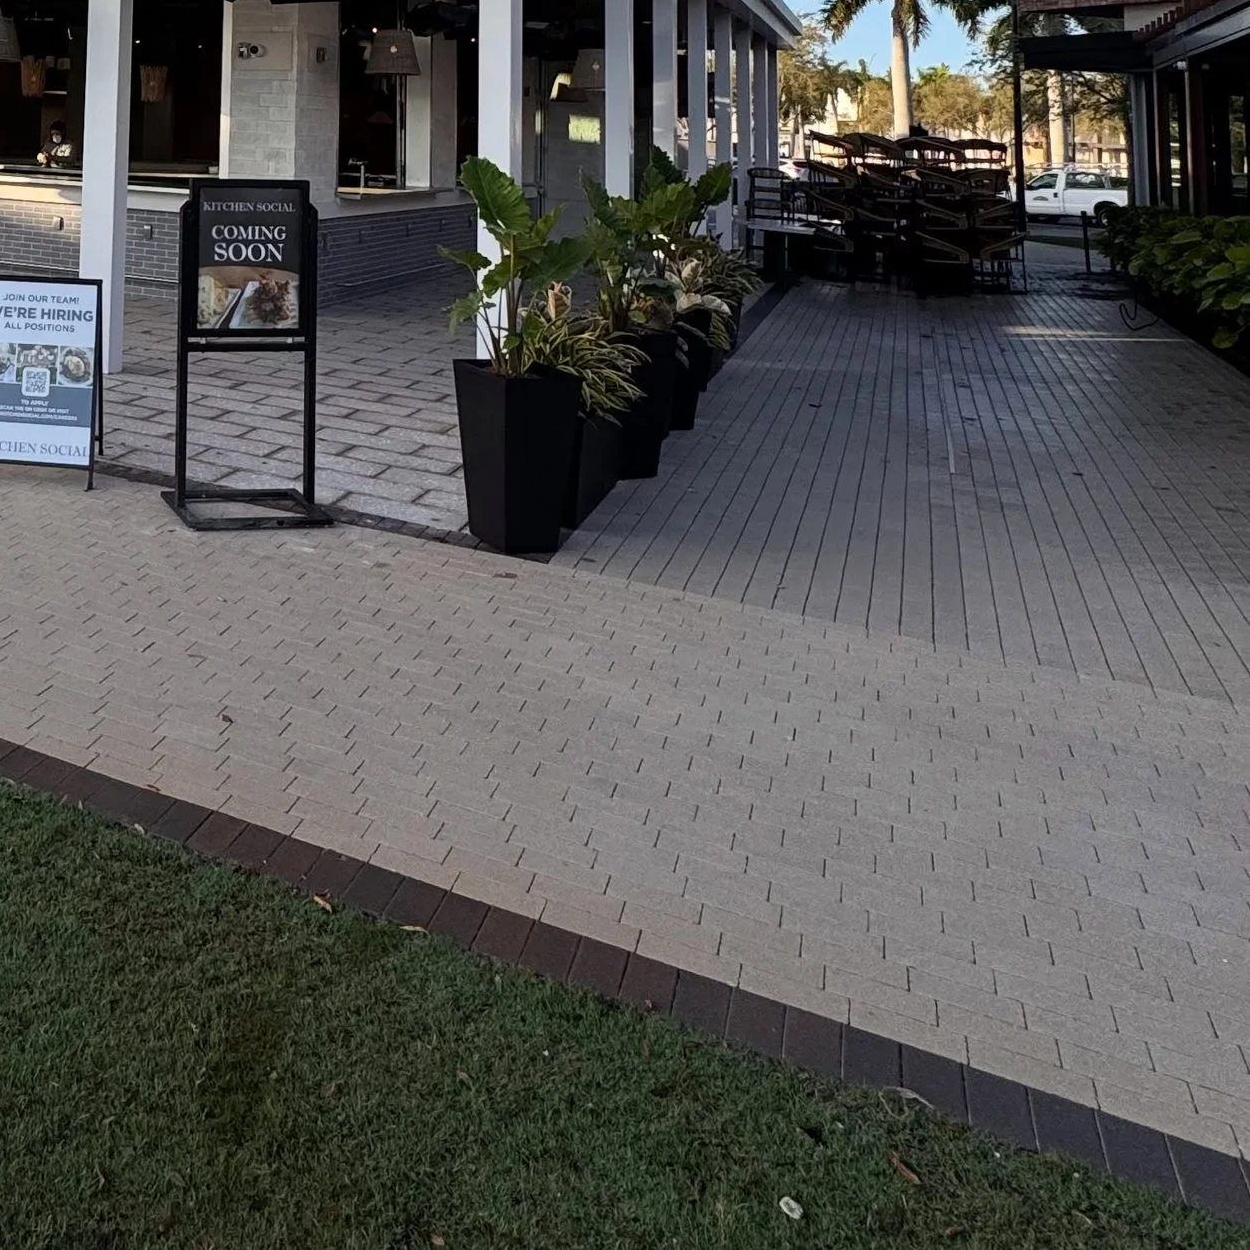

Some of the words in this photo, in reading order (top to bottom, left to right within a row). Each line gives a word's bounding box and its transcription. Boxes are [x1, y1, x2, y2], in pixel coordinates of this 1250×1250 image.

[203, 201, 254, 212] KITCHEN
[256, 202, 295, 213] SOCIAL
[211, 225, 287, 240] COMING
[214, 243, 284, 262] SOON
[3, 293, 25, 302] JOIN
[28, 294, 48, 303] OUR
[51, 295, 80, 304] TEAM!
[41, 308, 93, 322] HIRING
[4, 321, 22, 330] ALL
[24, 322, 75, 333] POSITIONS
